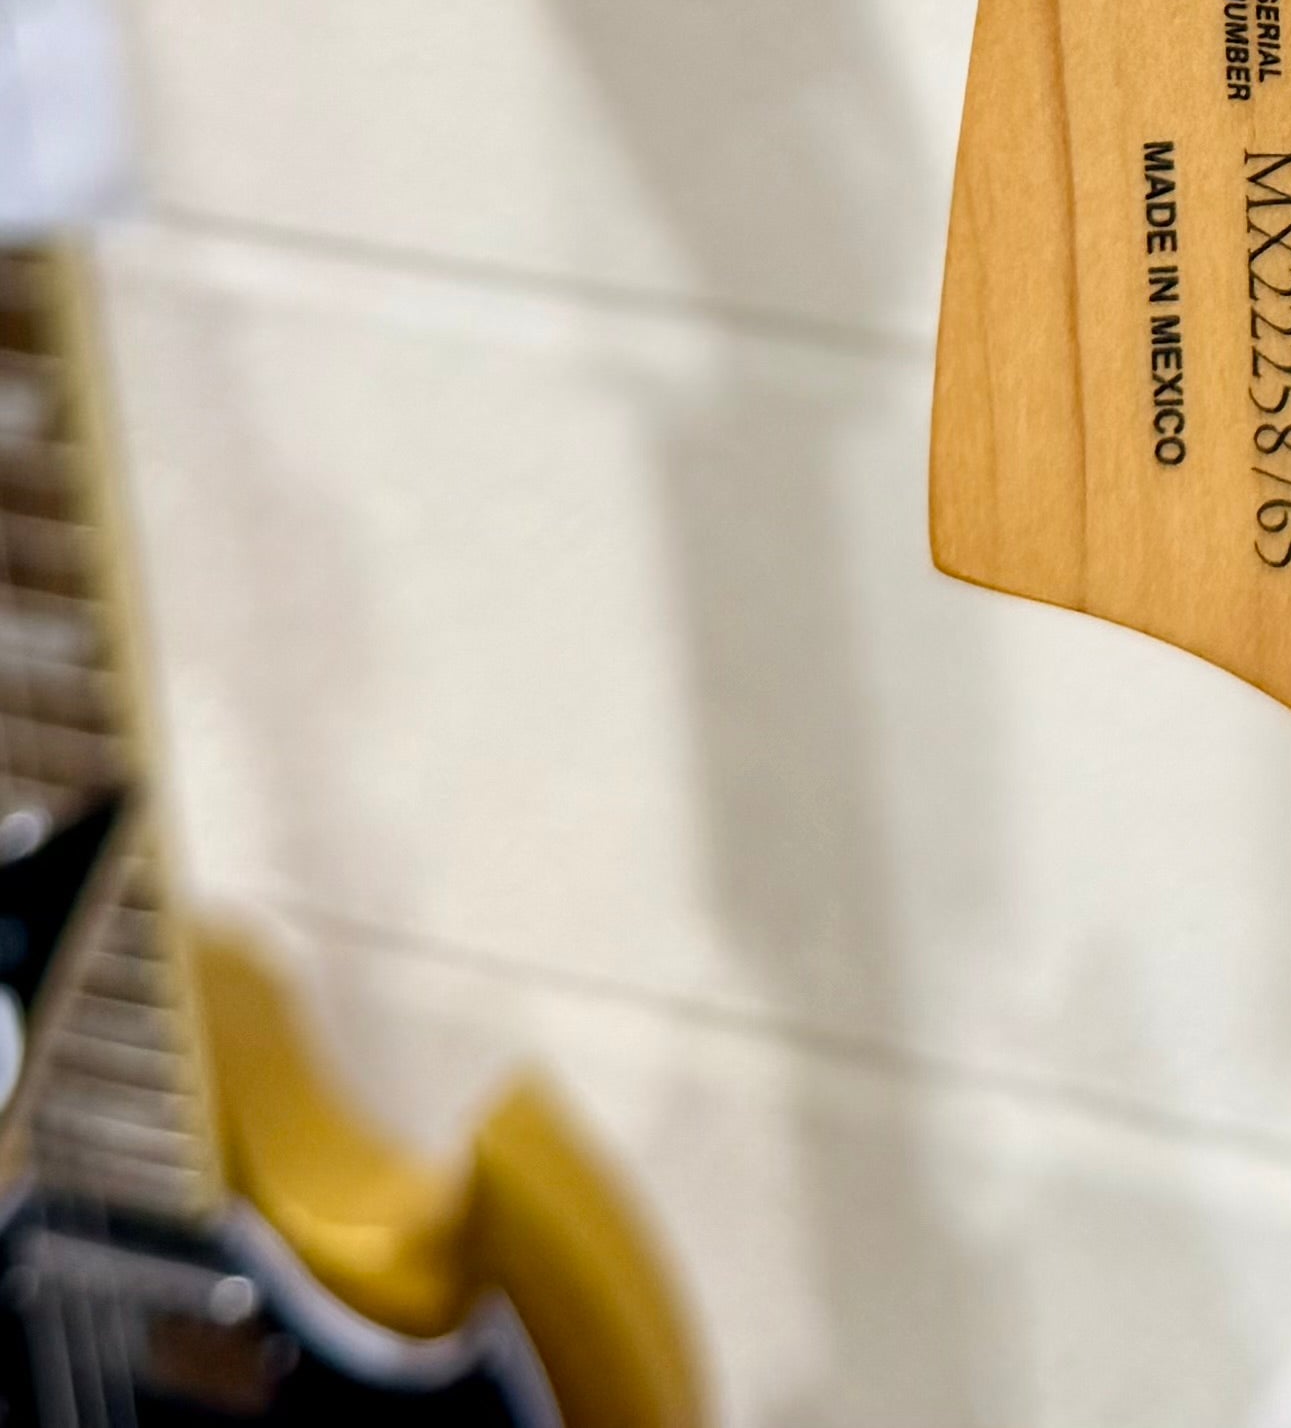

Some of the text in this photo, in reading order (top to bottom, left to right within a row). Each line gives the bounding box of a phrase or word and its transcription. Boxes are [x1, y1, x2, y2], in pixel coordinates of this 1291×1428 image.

[1142, 139, 1188, 468] MADE IN MEXICO
